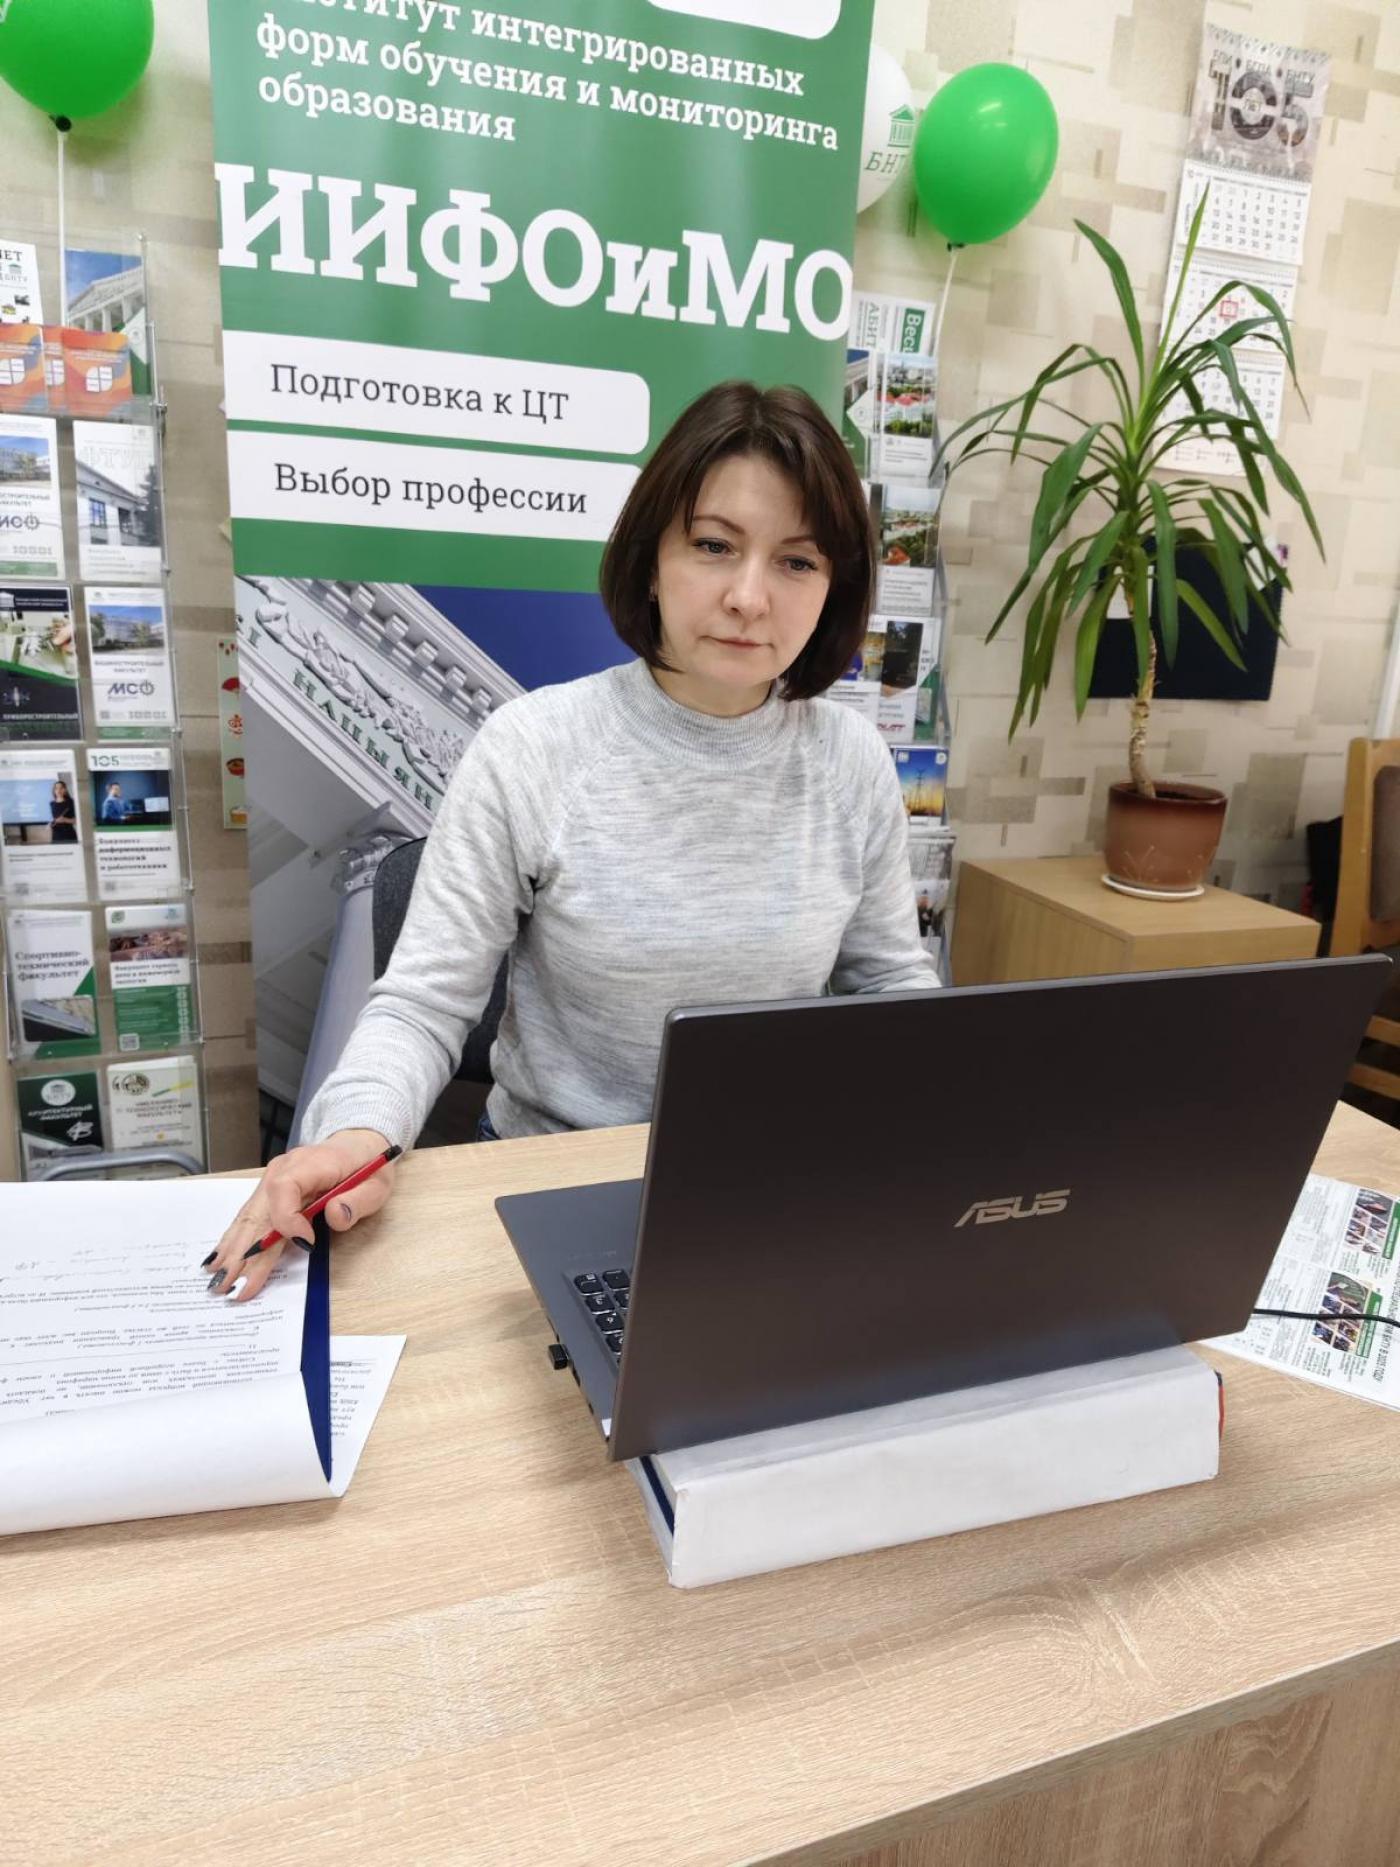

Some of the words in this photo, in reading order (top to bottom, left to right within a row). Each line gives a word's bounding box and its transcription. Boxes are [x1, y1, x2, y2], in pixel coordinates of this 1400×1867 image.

[256, 12, 370, 67] форм
[380, 41, 567, 100] обучения
[577, 79, 600, 107] и
[610, 86, 838, 150] мониторинга
[471, 9, 804, 96] интегрированных
[258, 71, 516, 141] образования
[0, 249, 23, 261] ЕТ
[215, 162, 854, 341] ИИФОиМО
[271, 364, 483, 412] Подготовка
[493, 392, 513, 415] к
[522, 389, 569, 424] ЦТ
[274, 463, 391, 505] Выбор
[402, 478, 588, 513] профессии
[954, 1189, 1070, 1228] ASUS
